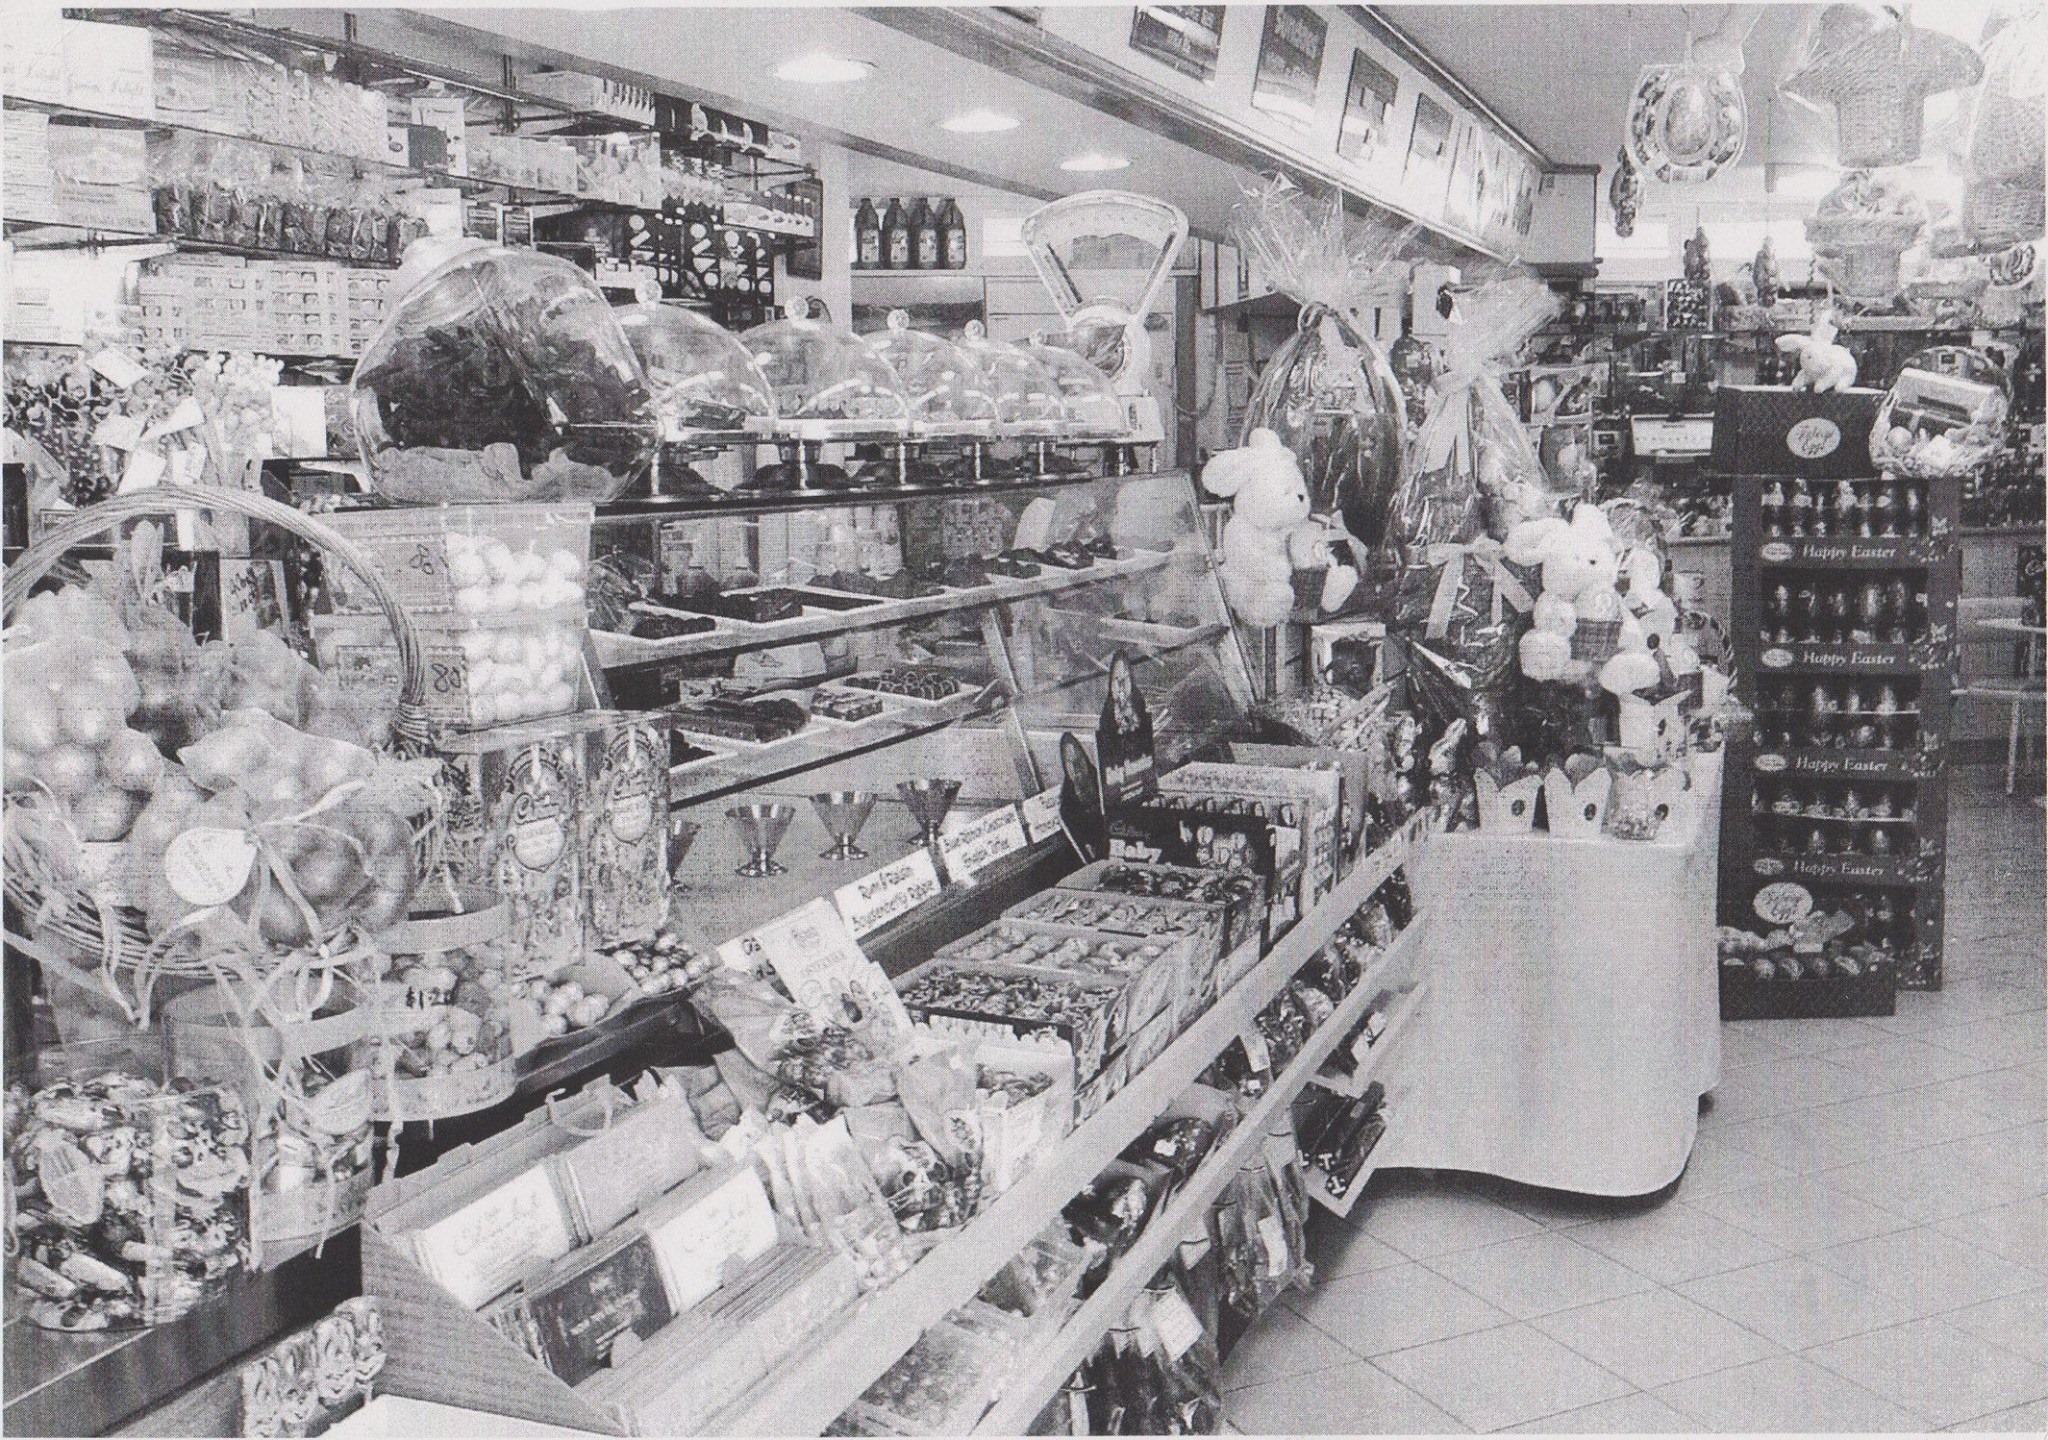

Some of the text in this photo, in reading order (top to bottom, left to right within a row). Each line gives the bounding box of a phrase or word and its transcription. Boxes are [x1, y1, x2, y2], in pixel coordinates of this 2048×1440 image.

[1802, 544, 1848, 560] Happy
[1850, 544, 1897, 559] Easter
[1802, 650, 1847, 666] Happy
[1850, 651, 1896, 665] Easter
[1795, 755, 1840, 772] Happy
[1844, 758, 1889, 771] Easter
[1792, 859, 1837, 877] Happy
[1840, 862, 1885, 876] Easter
